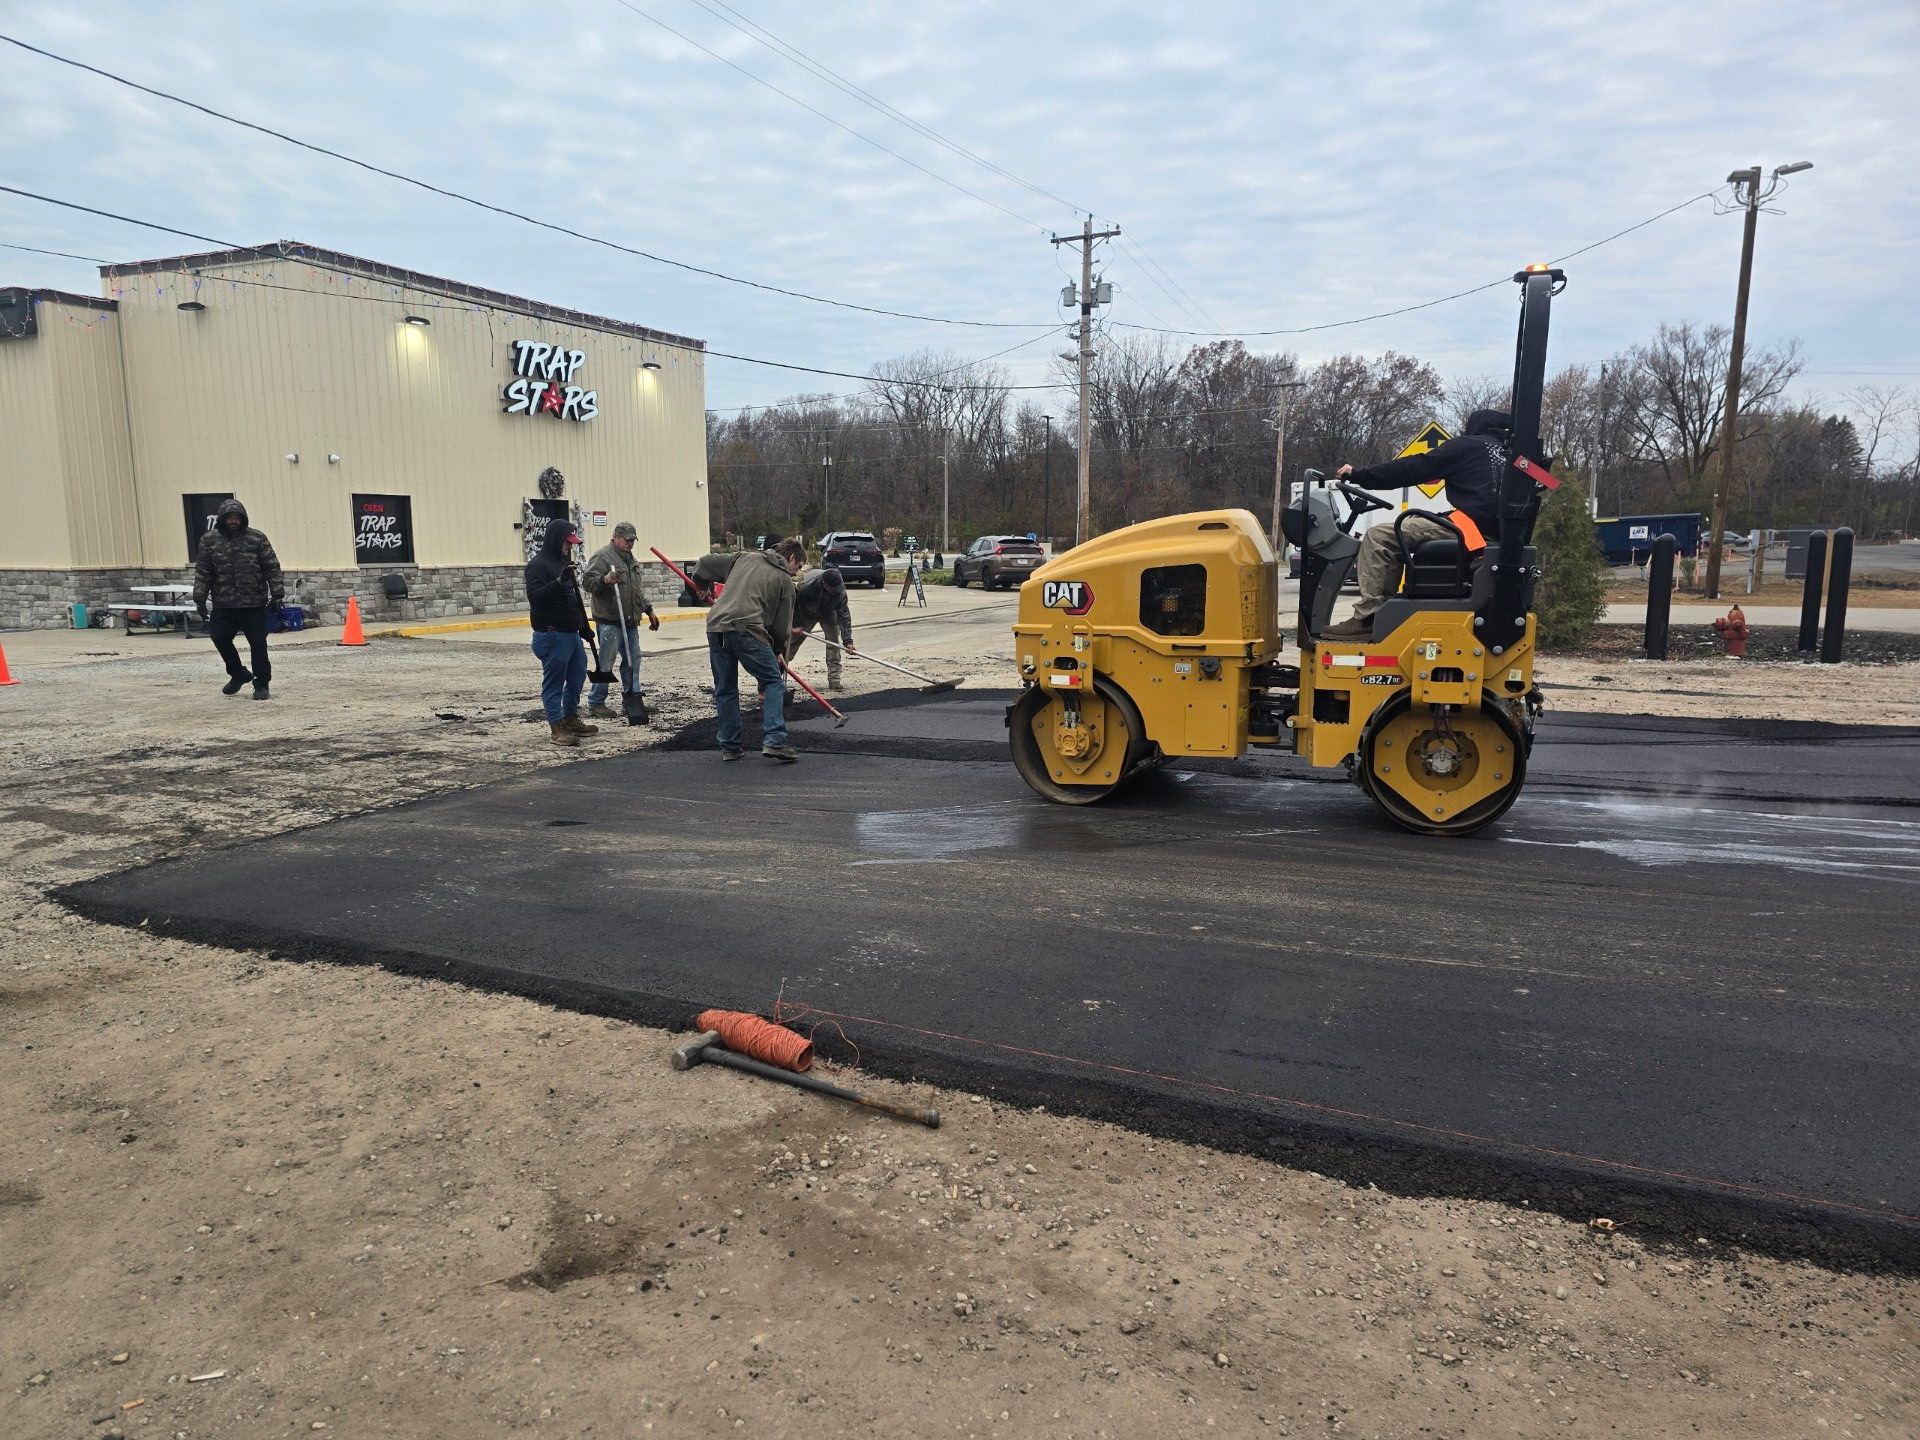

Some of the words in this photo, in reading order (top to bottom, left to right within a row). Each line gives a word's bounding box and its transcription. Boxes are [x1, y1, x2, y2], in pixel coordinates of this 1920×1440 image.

[515, 340, 586, 382] TRAP
[361, 515, 396, 531] TRAP
[1044, 582, 1082, 608] CAT
